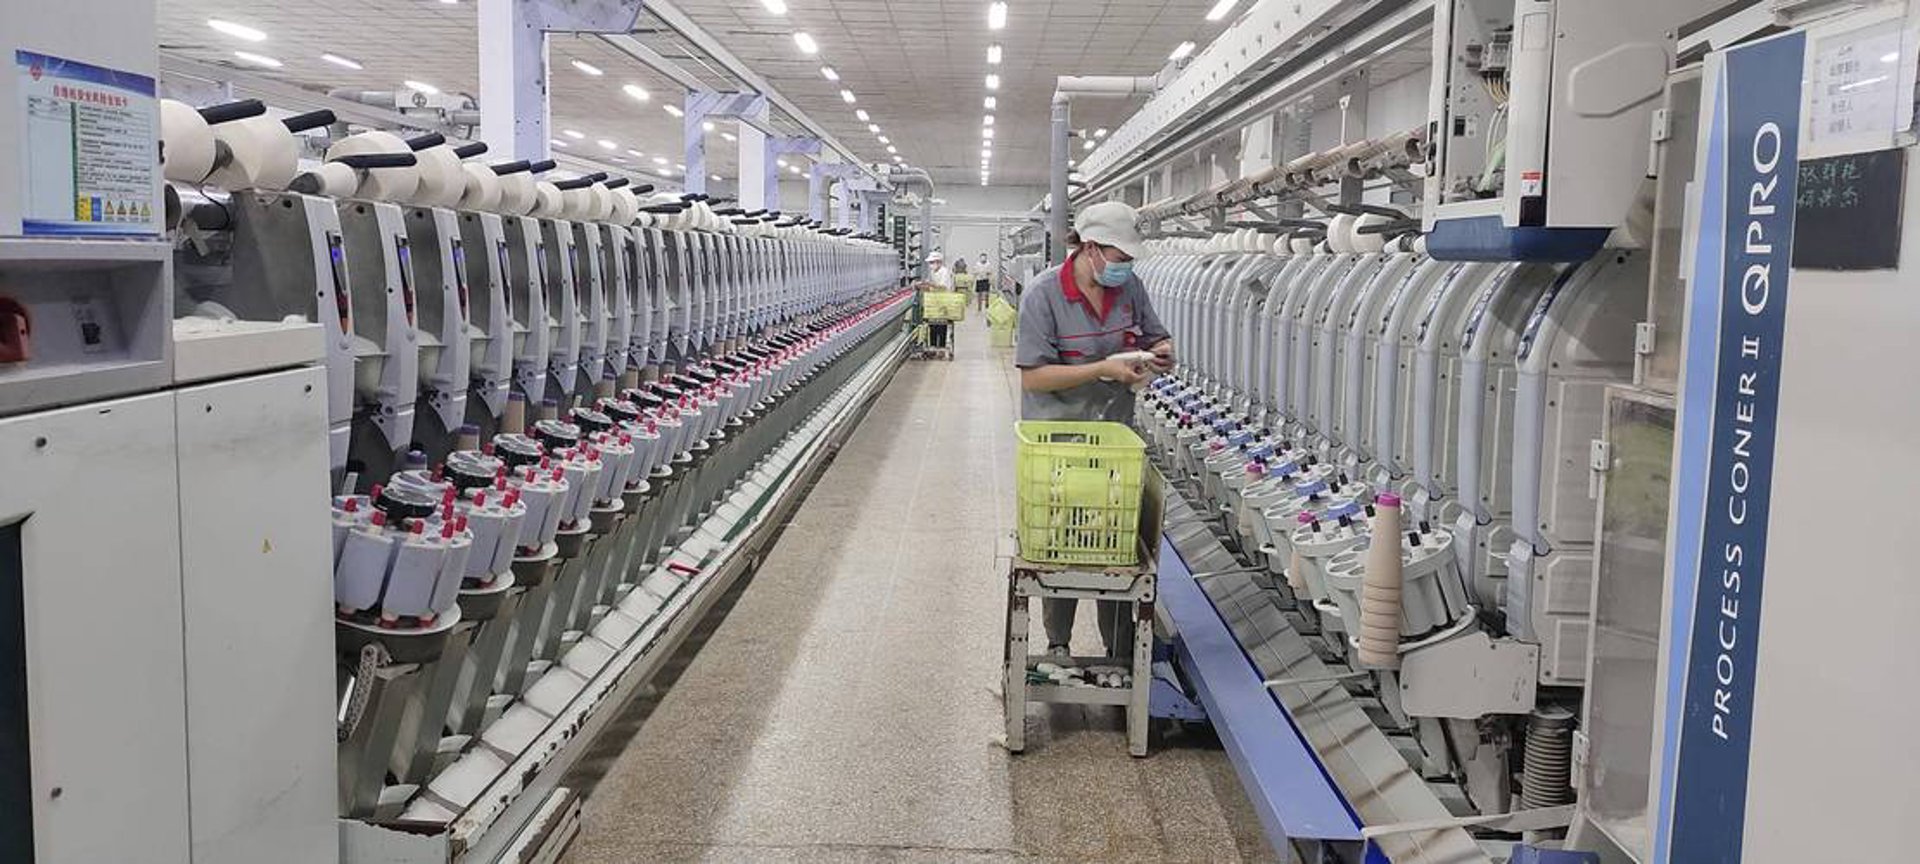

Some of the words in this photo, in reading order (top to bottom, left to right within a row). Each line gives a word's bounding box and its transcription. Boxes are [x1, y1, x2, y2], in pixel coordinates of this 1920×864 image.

[1741, 121, 1782, 316] QPRO
[1729, 372, 1757, 525] CONER
[1712, 542, 1744, 740] PROCESS
